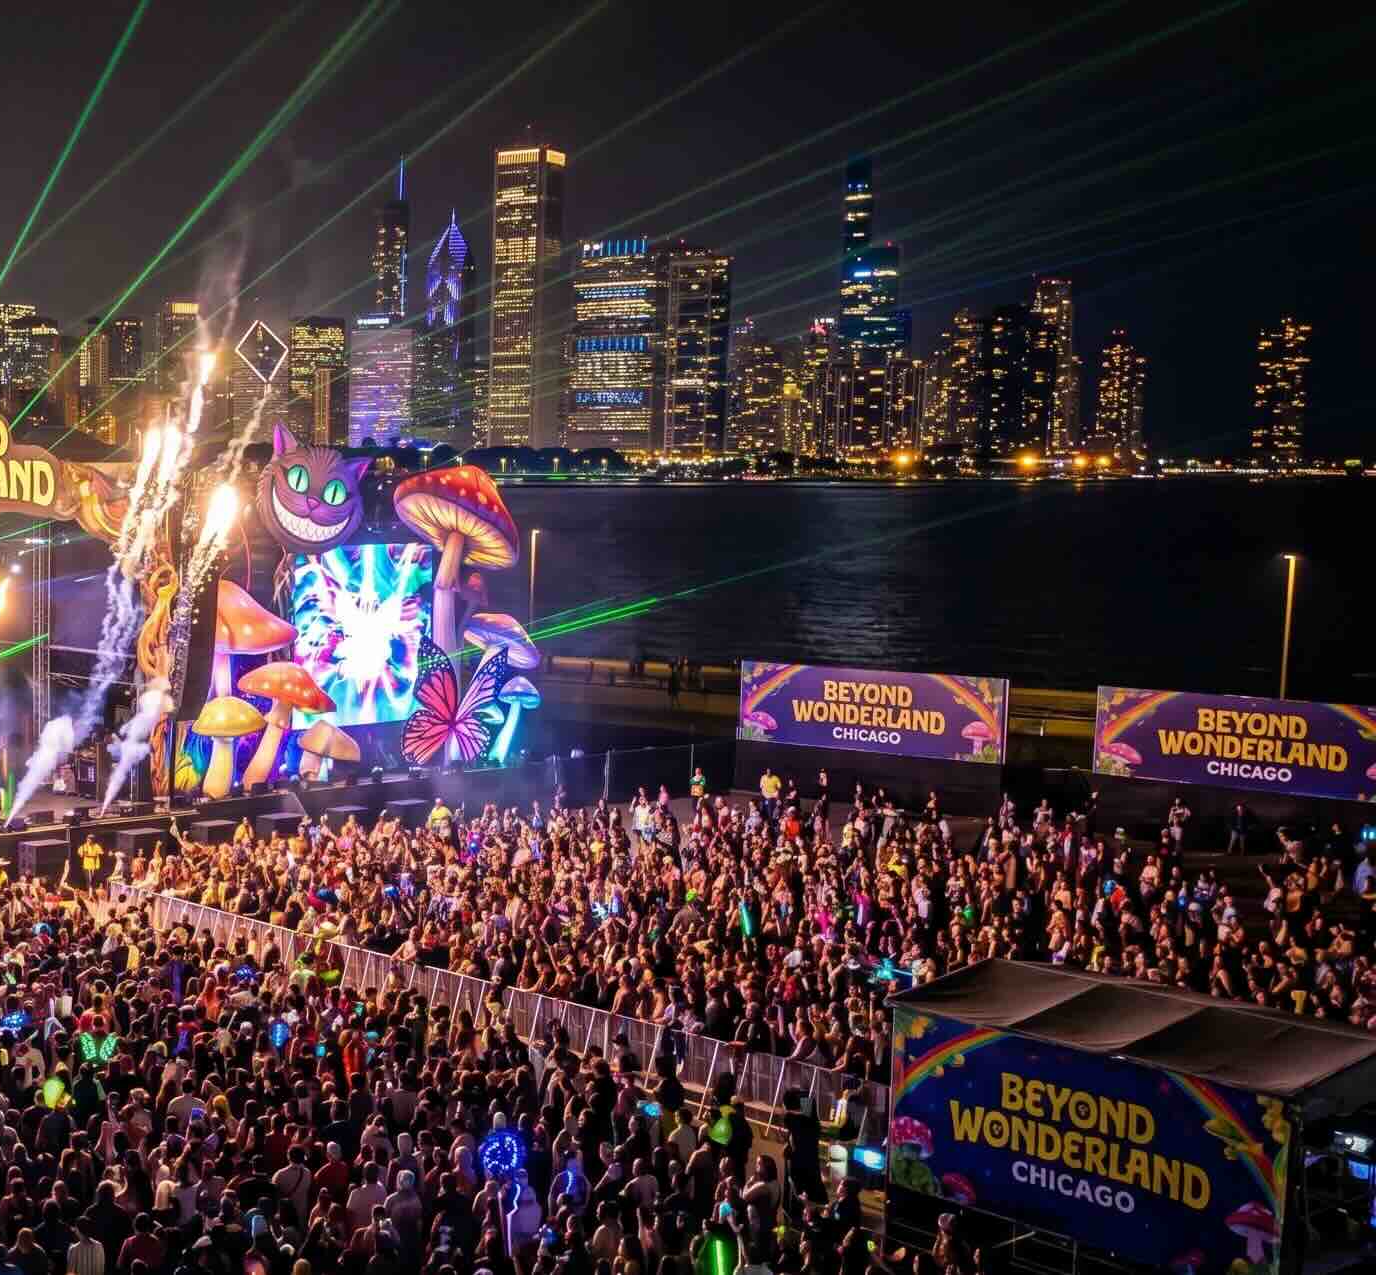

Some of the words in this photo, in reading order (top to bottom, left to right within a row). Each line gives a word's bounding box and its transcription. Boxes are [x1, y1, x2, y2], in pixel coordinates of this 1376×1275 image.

[824, 680, 913, 707] BEYOND
[792, 699, 945, 735] WONDERLAND
[1197, 708, 1308, 739] BEYOND
[832, 726, 901, 745] CHICAGO
[1158, 729, 1348, 772] WONDERLAND
[1207, 761, 1292, 782] CHICAGO
[1000, 1072, 1156, 1144] BEYOND
[949, 1100, 1211, 1209] WONDERLAND
[1012, 1161, 1135, 1214] CHICAGO
